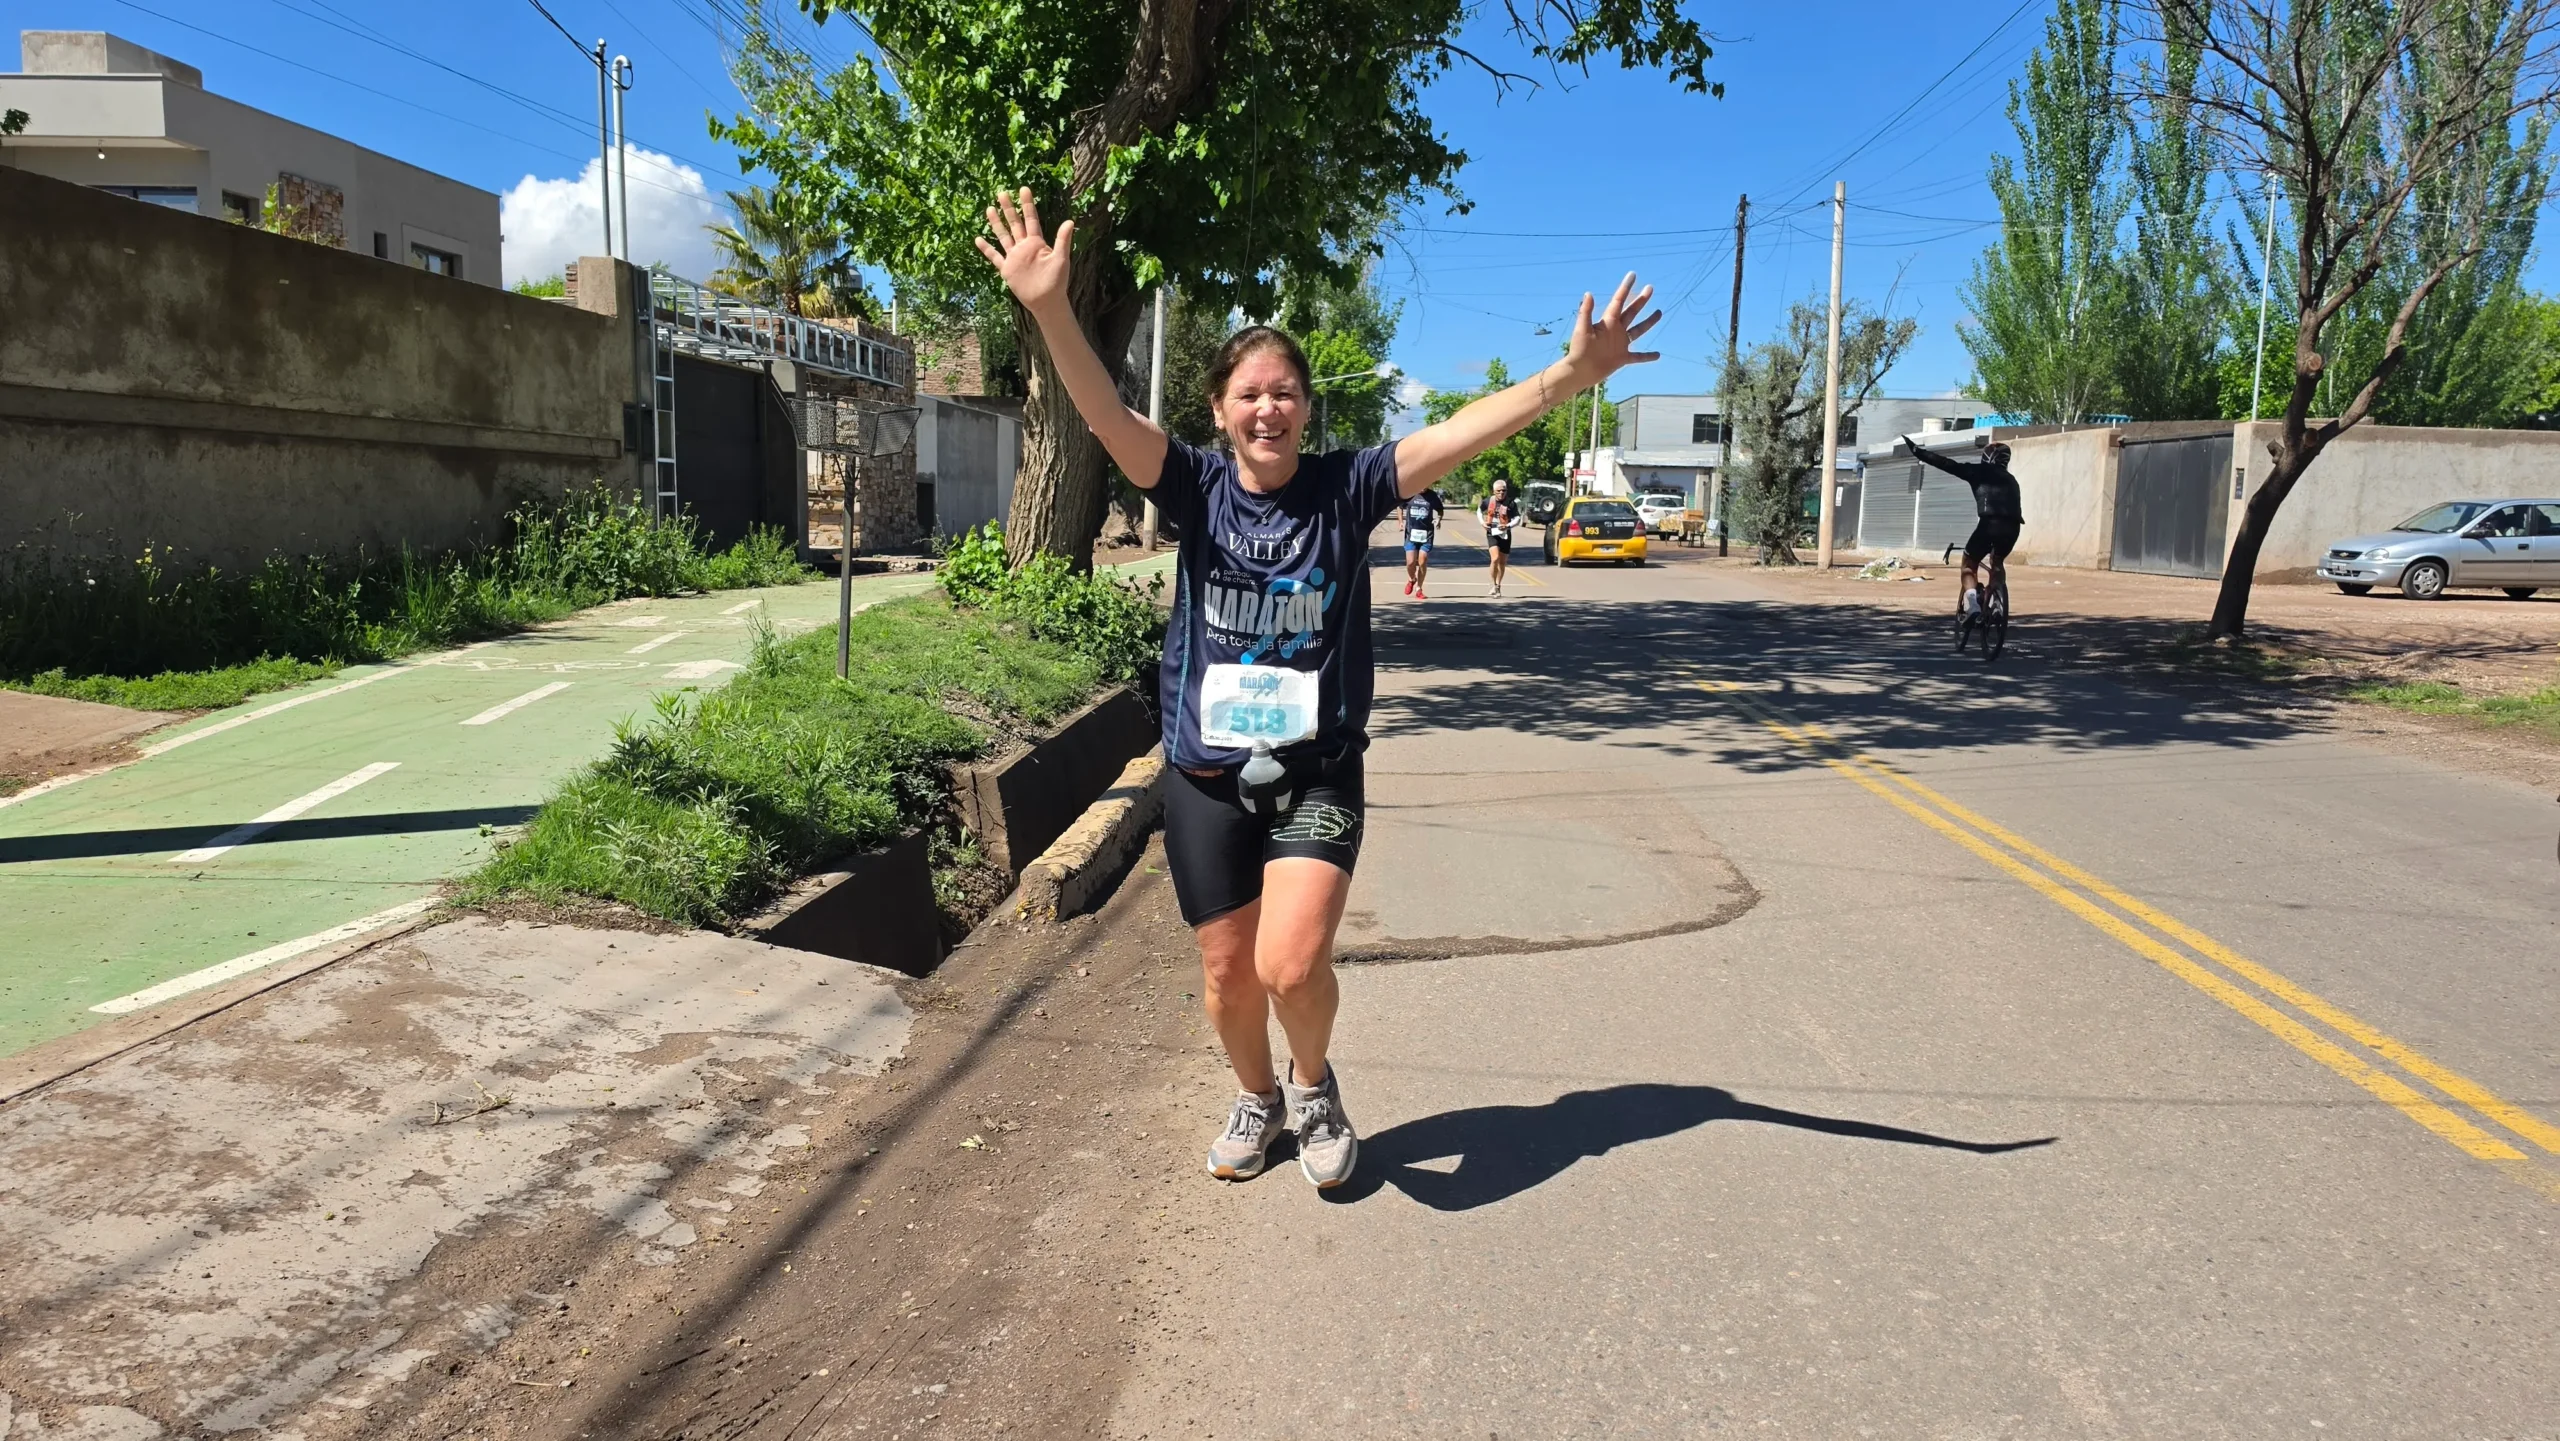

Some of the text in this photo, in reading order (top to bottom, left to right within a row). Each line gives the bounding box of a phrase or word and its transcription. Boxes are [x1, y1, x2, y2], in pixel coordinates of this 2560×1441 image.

[1243, 527, 1292, 539] ALMARES
[1585, 527, 1599, 535] 993
[1229, 532, 1304, 560] VALLEY
[1223, 569, 1251, 578] parroqu
[1232, 577, 1258, 585] chacra
[1204, 581, 1323, 635] MARATON
[1229, 635, 1258, 650] toda
[1263, 638, 1274, 650] la
[1277, 635, 1323, 650] familia
[1229, 707, 1287, 734] 518
